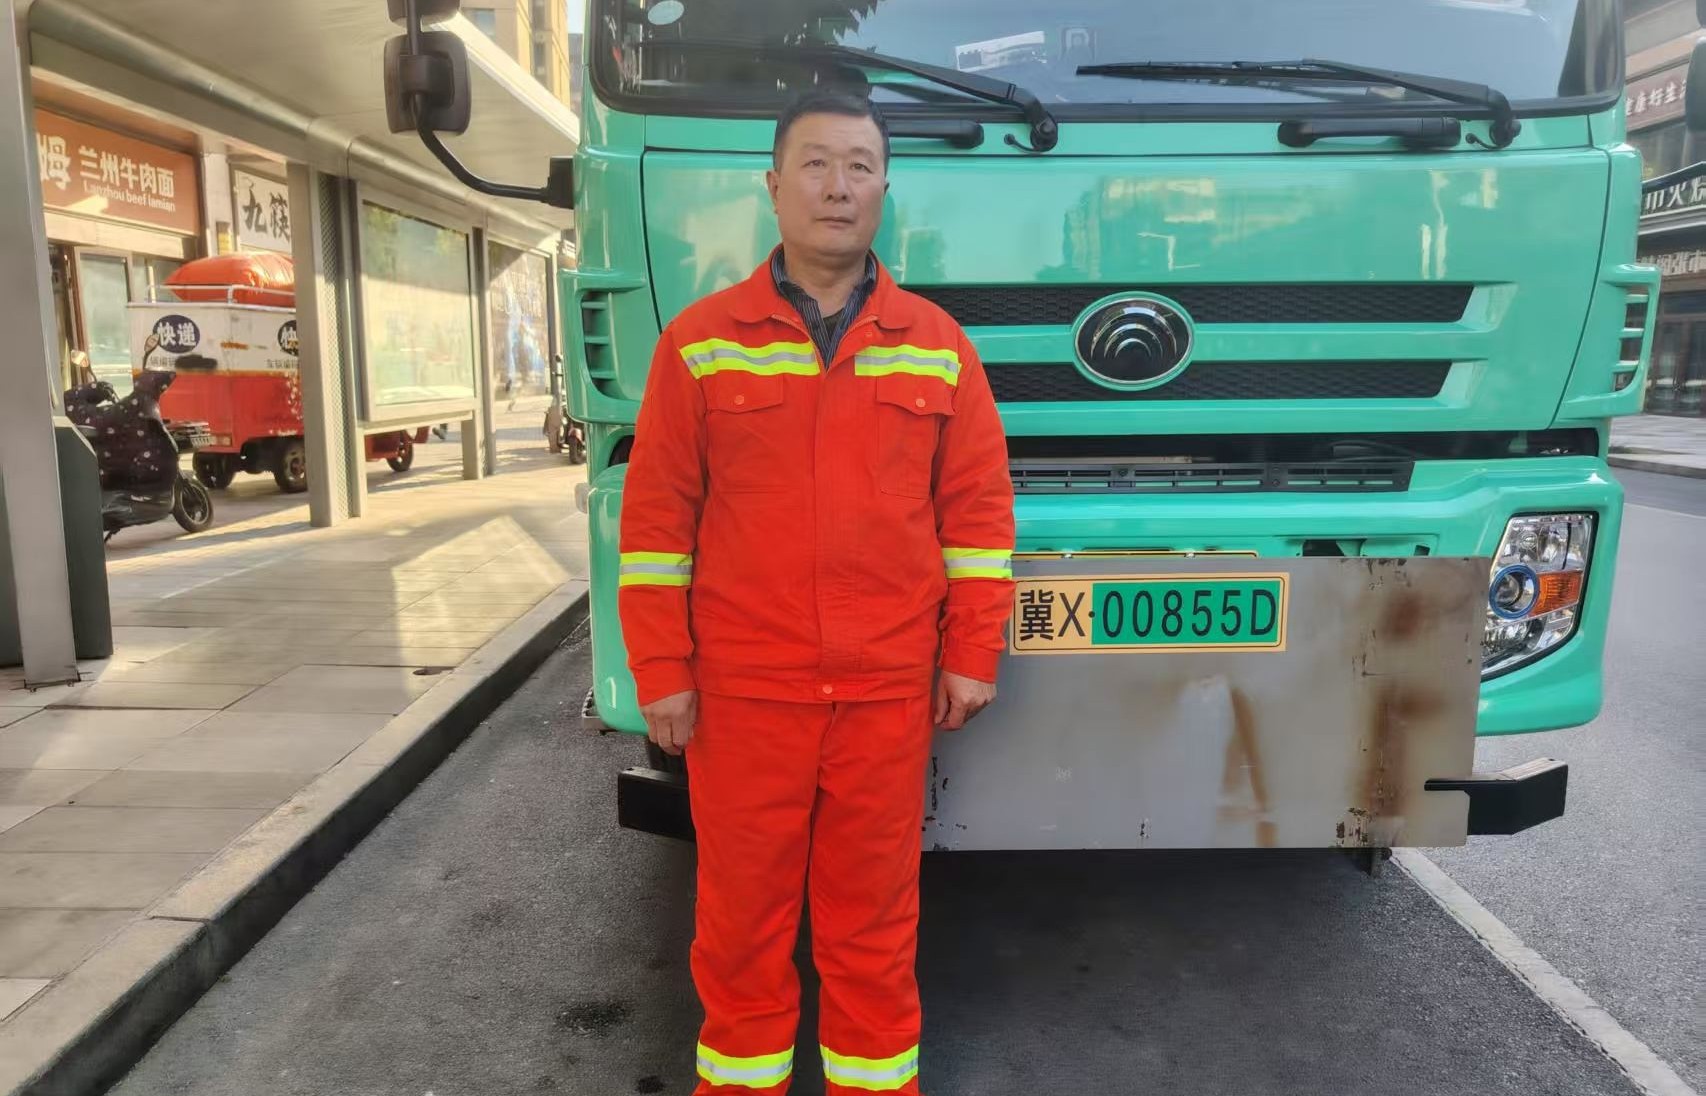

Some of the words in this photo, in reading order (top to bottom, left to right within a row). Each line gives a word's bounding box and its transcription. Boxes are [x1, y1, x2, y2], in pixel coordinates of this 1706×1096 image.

[78, 145, 174, 198] 兰州牛肉面
[126, 188, 146, 206] beef
[157, 322, 196, 346] 快递
